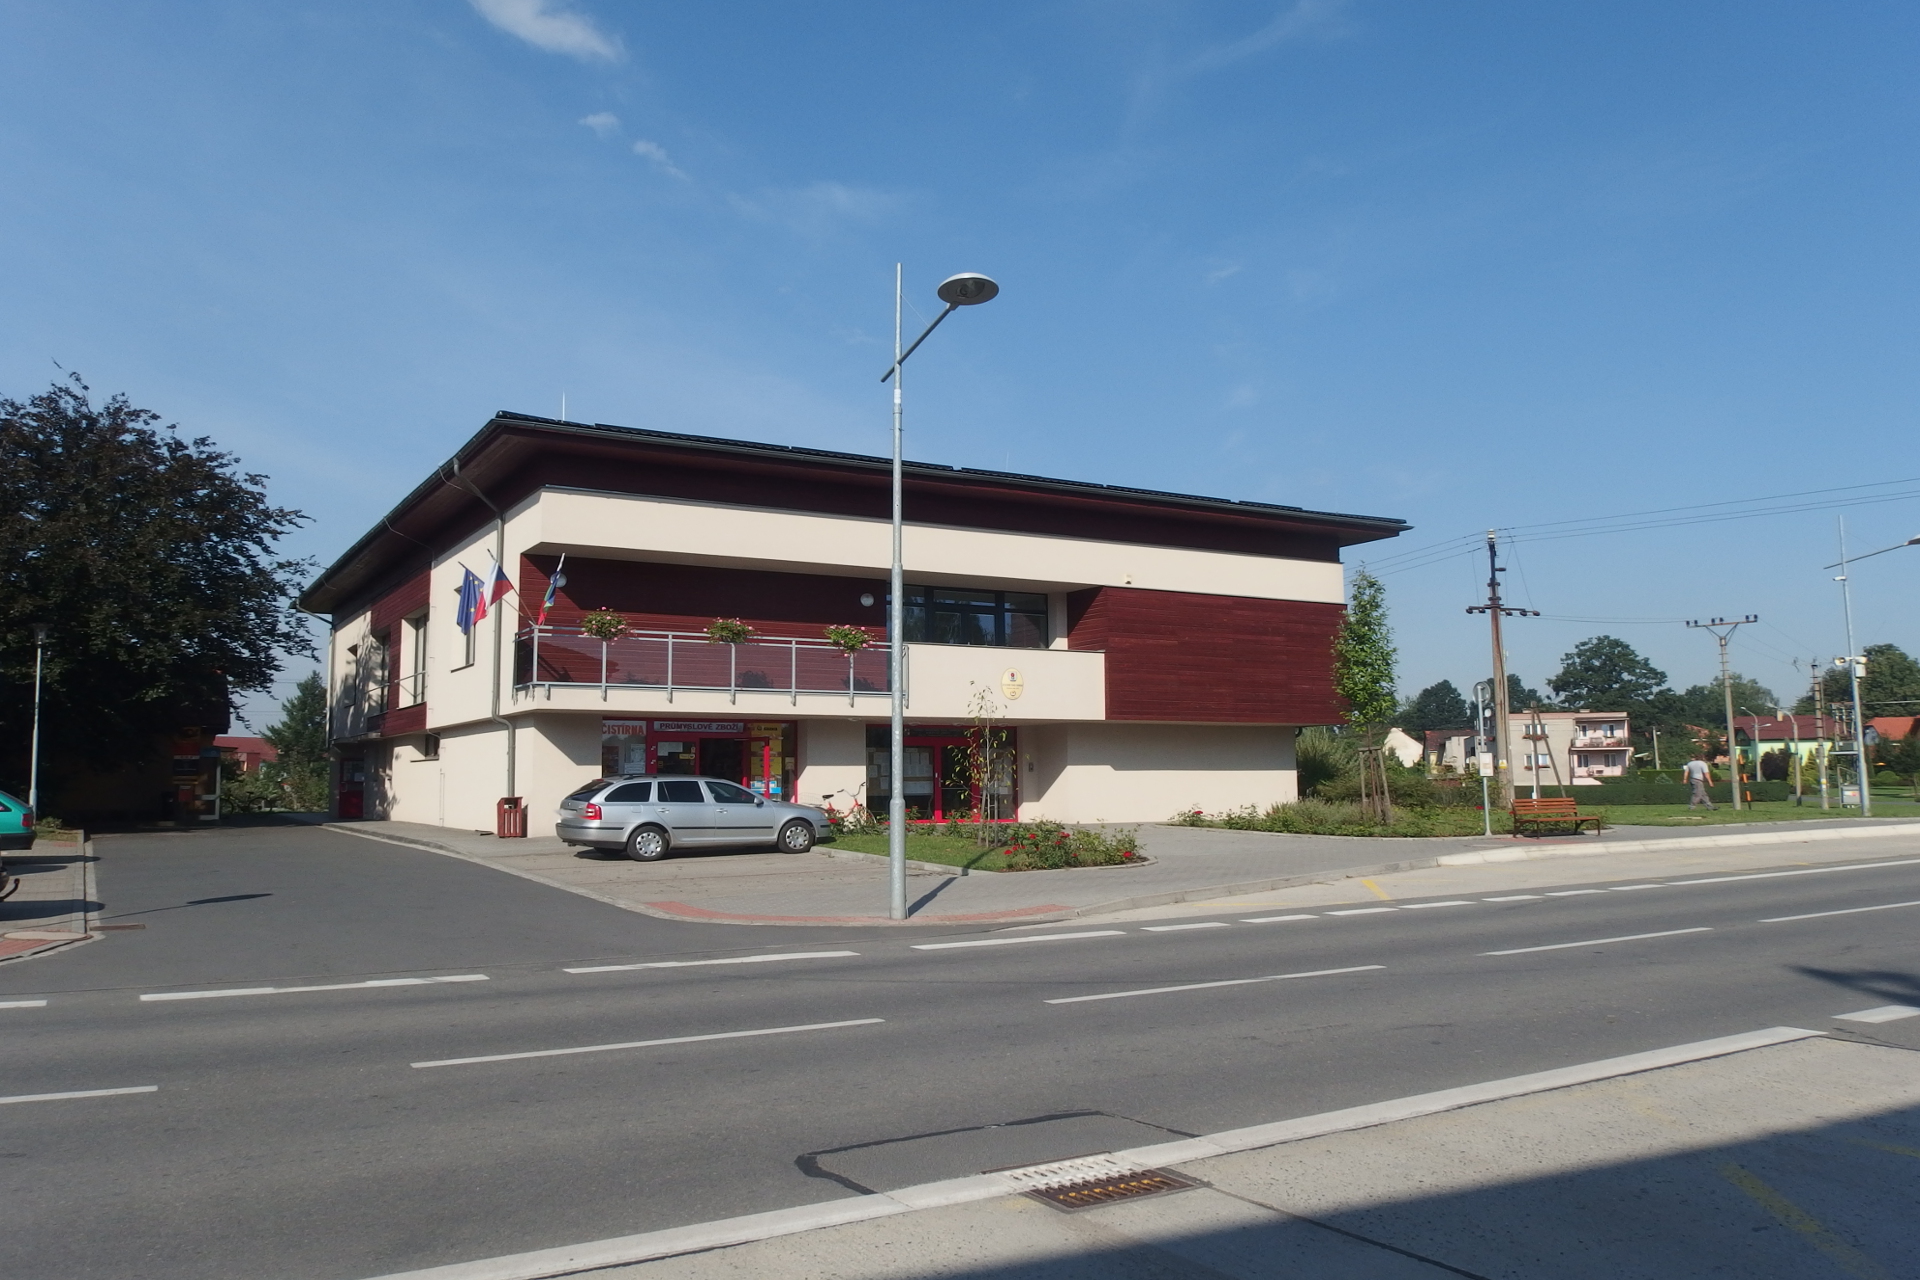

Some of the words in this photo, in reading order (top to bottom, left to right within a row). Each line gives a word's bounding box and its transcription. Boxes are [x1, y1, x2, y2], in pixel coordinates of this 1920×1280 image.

[602, 722, 645, 735] ČISTÍRNA
[659, 722, 713, 731] PRŮMYSLOVÉ
[715, 723, 739, 731] ZBOŽÍ
